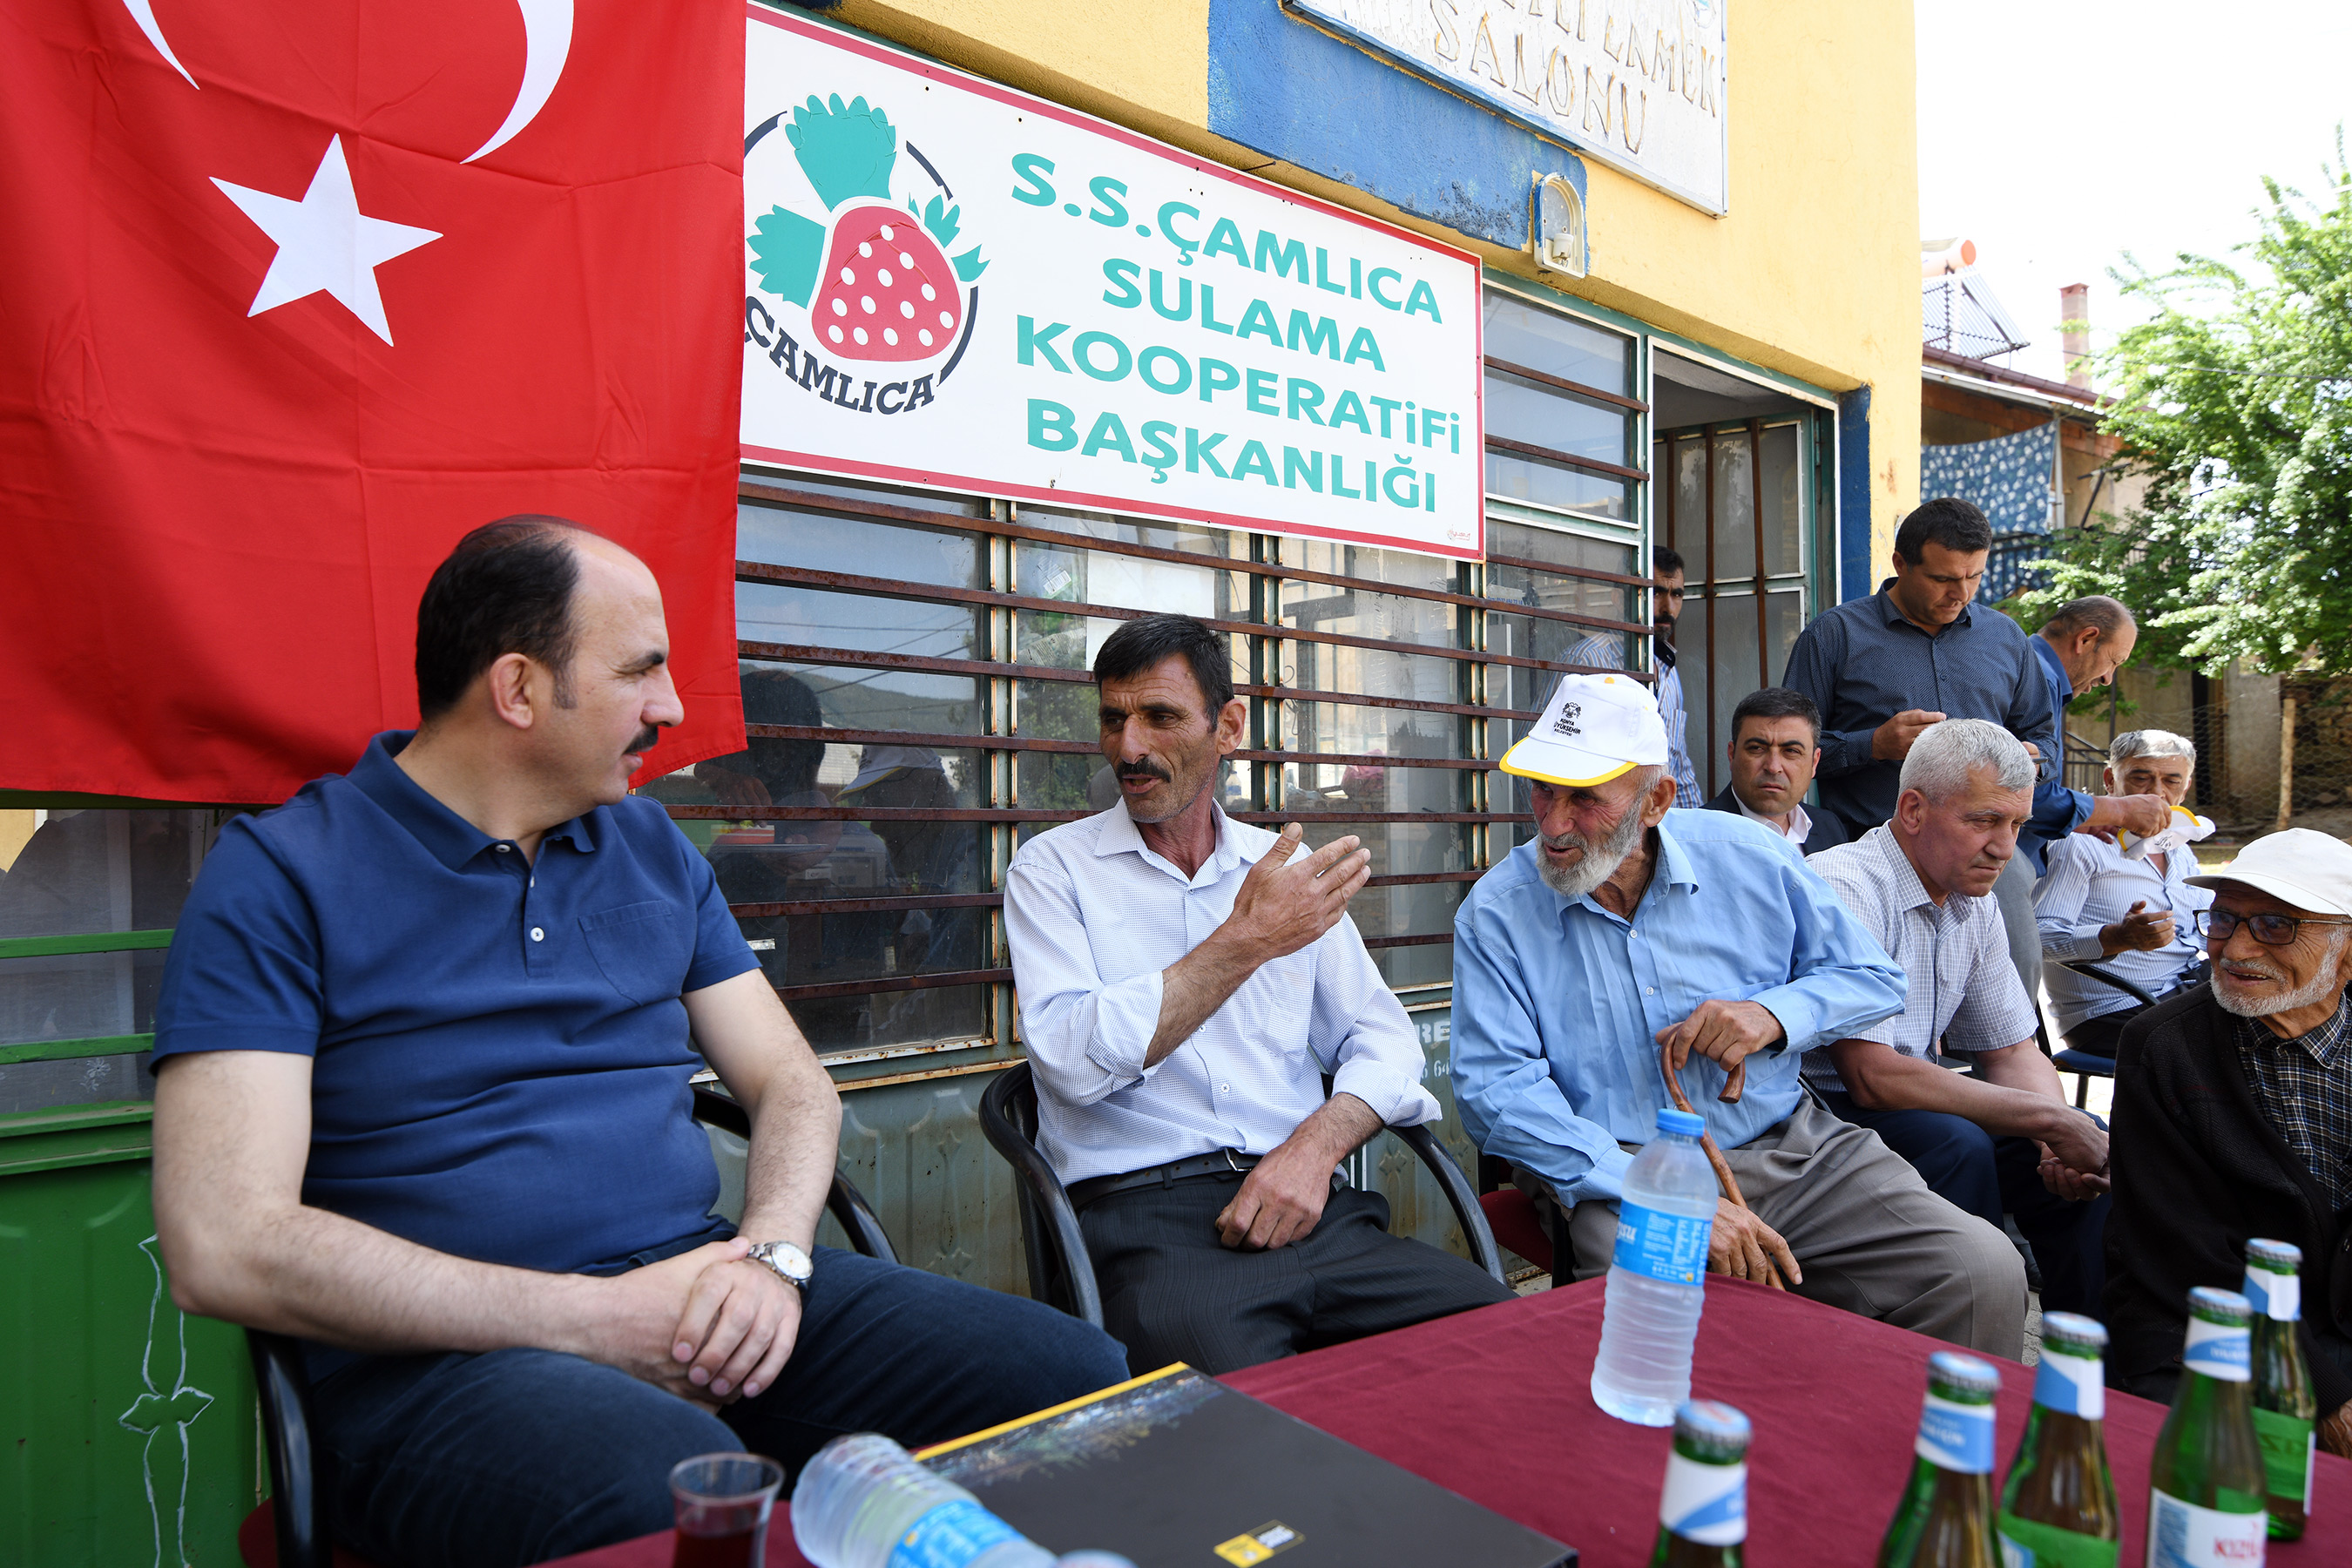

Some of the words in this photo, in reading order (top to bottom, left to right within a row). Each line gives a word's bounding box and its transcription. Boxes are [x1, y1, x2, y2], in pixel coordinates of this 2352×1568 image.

[1011, 152, 1443, 324] S.S.ÇAMLICA
[1102, 258, 1387, 373] SULAMA
[1027, 398, 1436, 513] BAŞKANLIĞI
